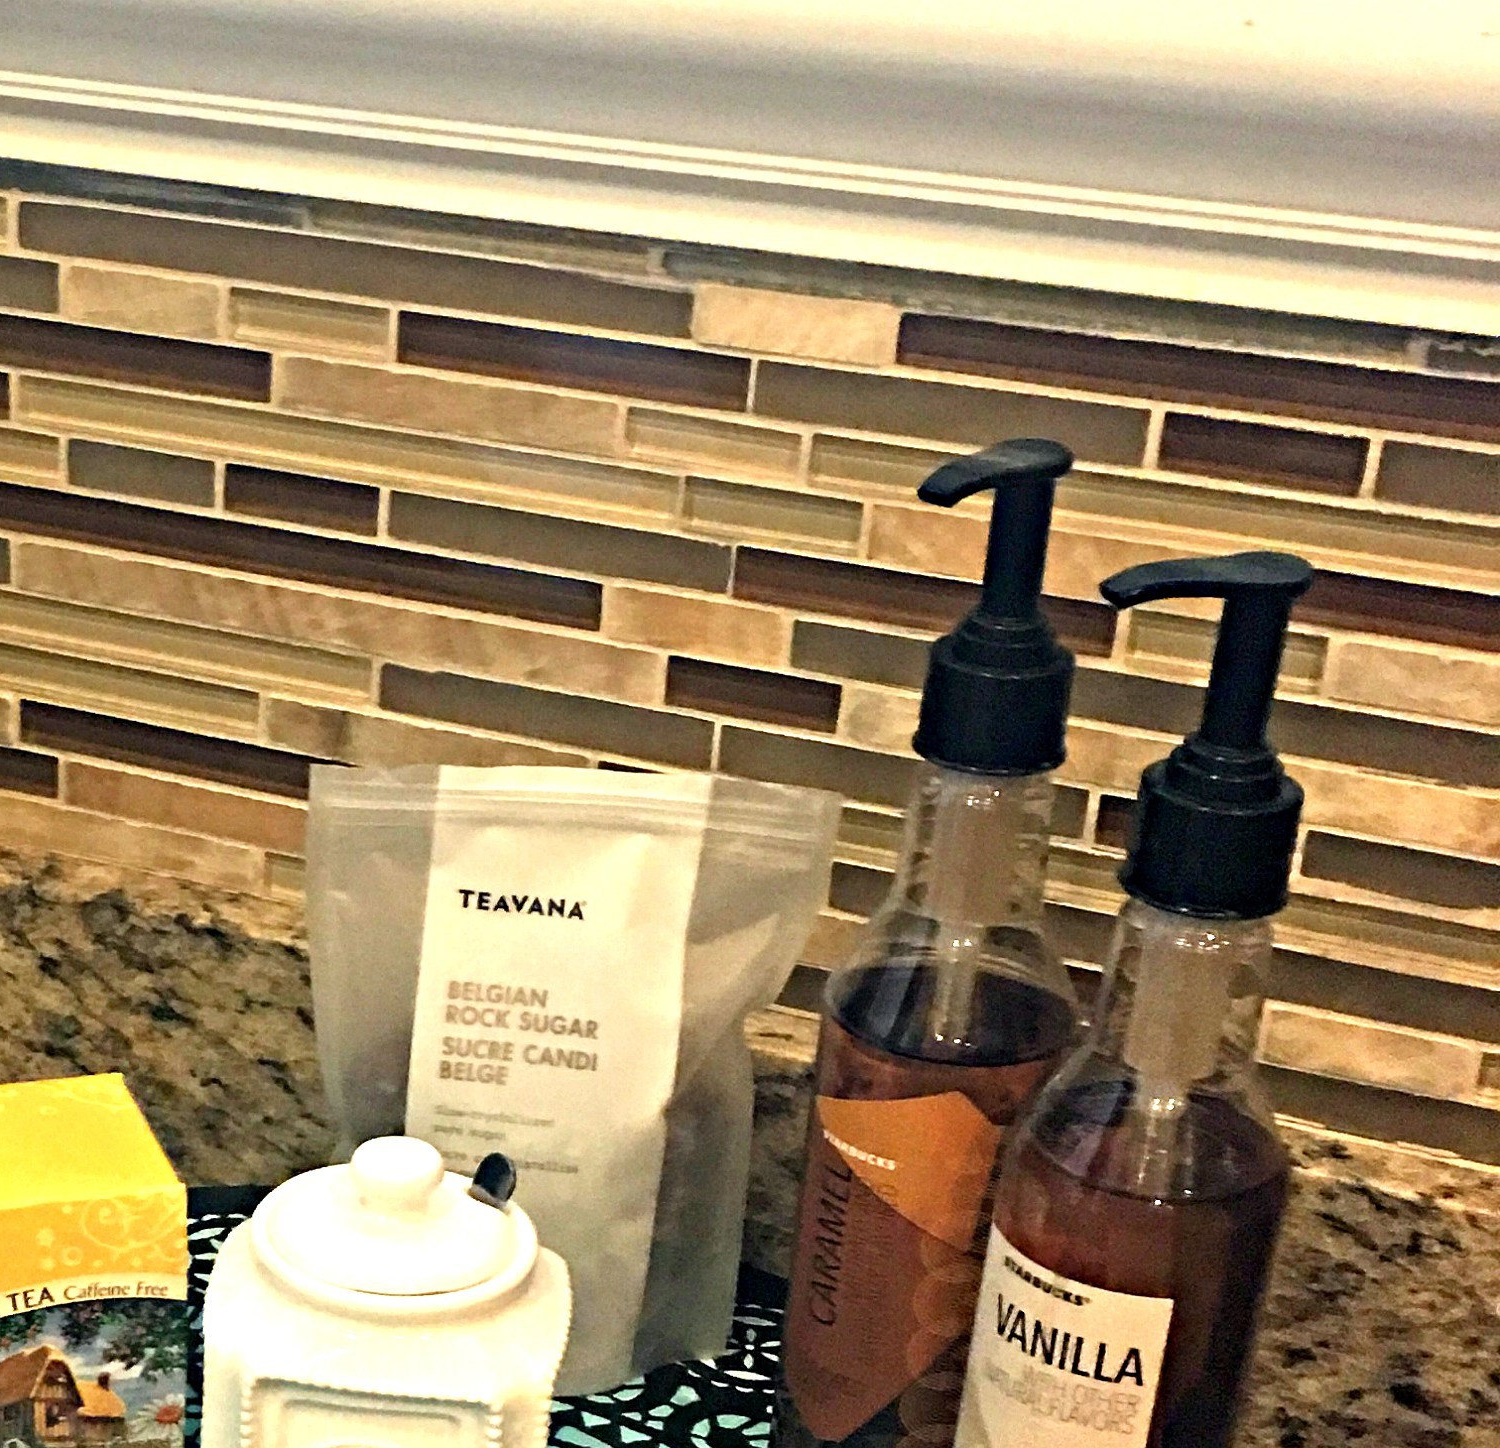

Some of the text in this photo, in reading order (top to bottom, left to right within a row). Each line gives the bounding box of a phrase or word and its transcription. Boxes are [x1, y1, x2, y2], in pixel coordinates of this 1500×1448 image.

[458, 889, 584, 921] TEAVANA
[447, 980, 549, 1008] BELGIAN
[444, 1005, 599, 1039] ROCK SUGAR
[442, 1036, 598, 1071] SUCRE CANDI
[439, 1060, 509, 1086] BELGE
[811, 1165, 852, 1326] CARAMEL
[6, 1287, 55, 1312] TEA
[63, 1283, 131, 1301] Caffeine
[135, 1281, 169, 1297] Free
[1004, 1256, 1085, 1306] STARBUCKS
[997, 1293, 1143, 1386] VANILLA
